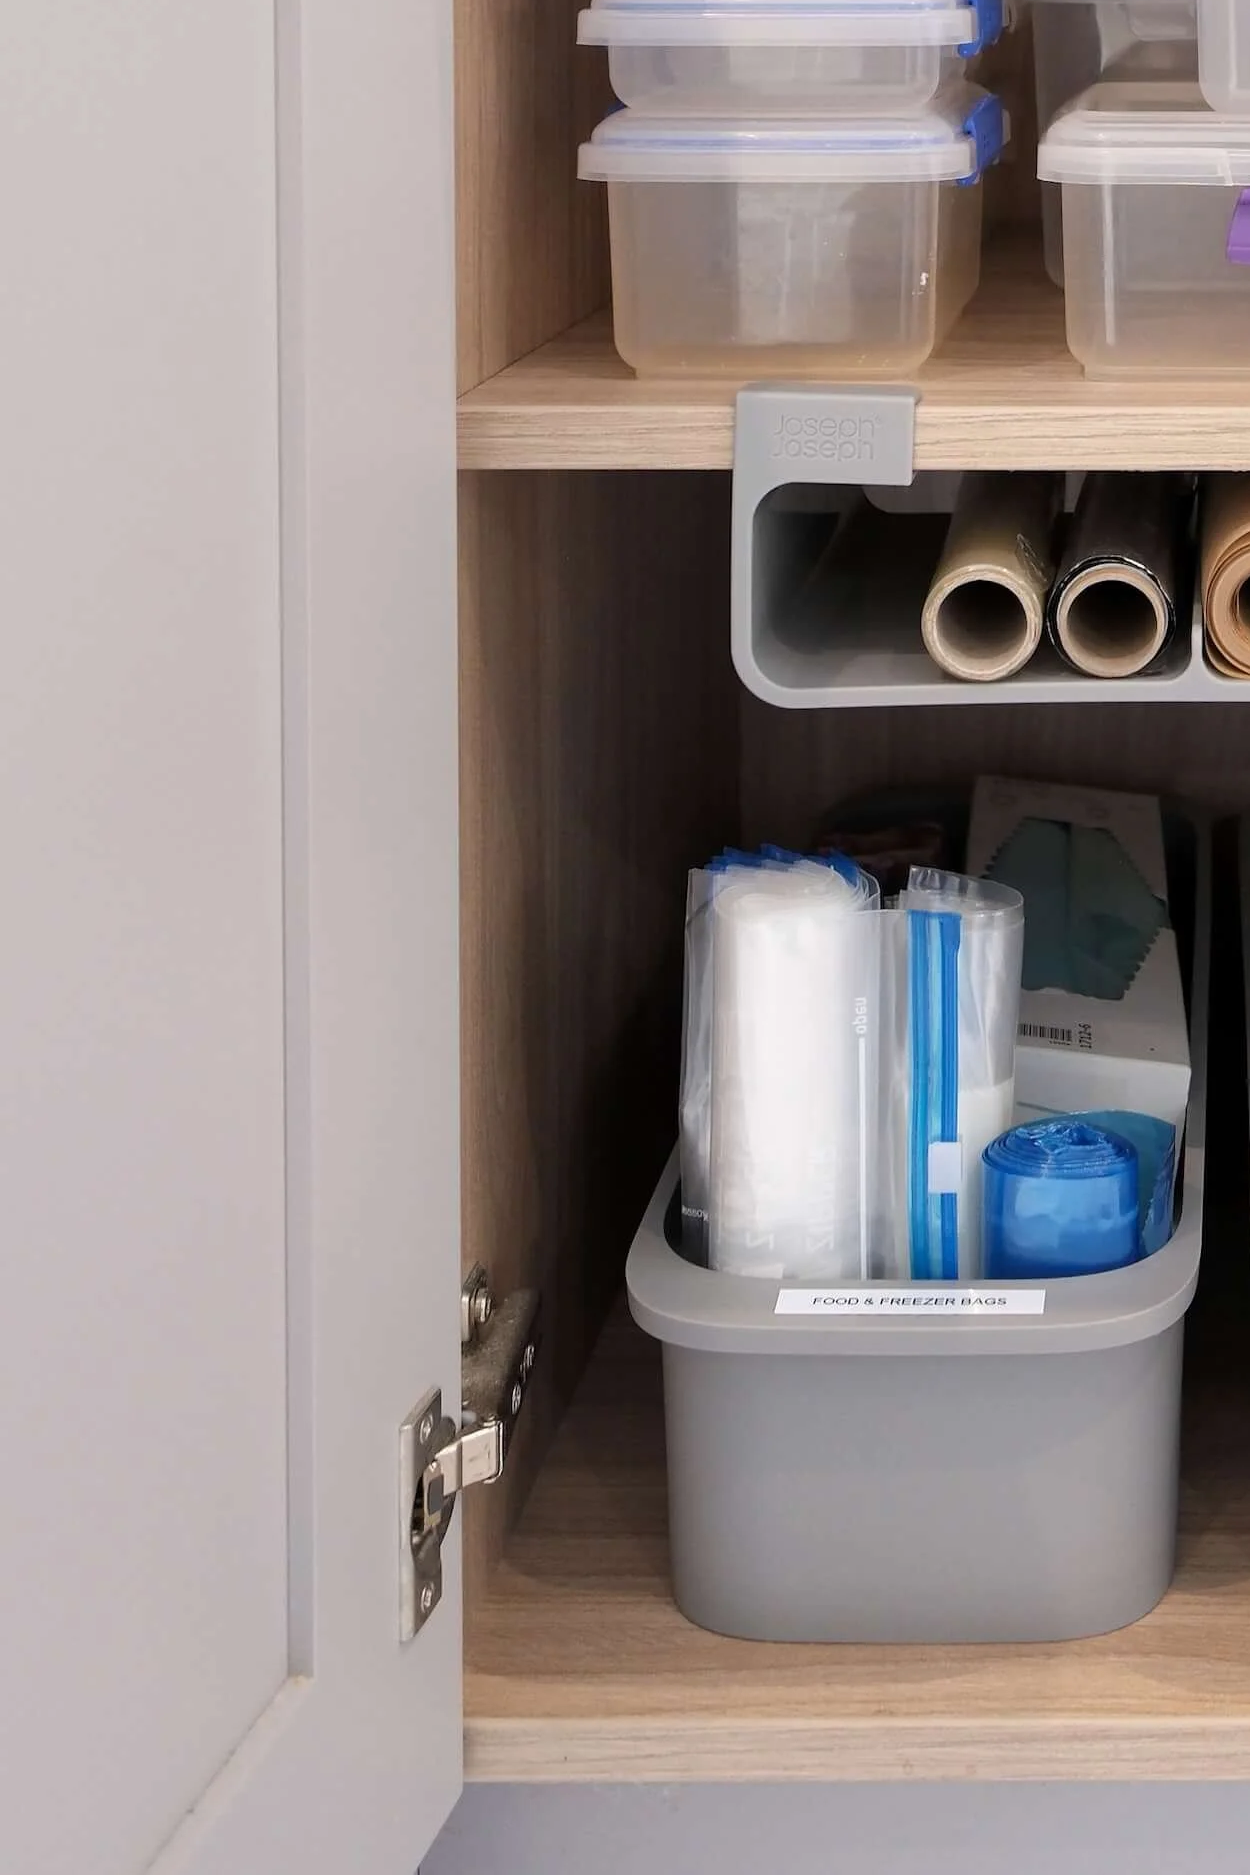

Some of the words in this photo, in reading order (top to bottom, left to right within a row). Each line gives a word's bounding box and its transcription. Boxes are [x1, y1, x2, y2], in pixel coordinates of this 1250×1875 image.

[773, 414, 875, 439] Joseph
[771, 436, 874, 462] Joseph
[811, 1296, 859, 1306] FOOD
[863, 1296, 875, 1306] &
[879, 1296, 956, 1306] FREEZER
[960, 1296, 1008, 1306] BAGS
